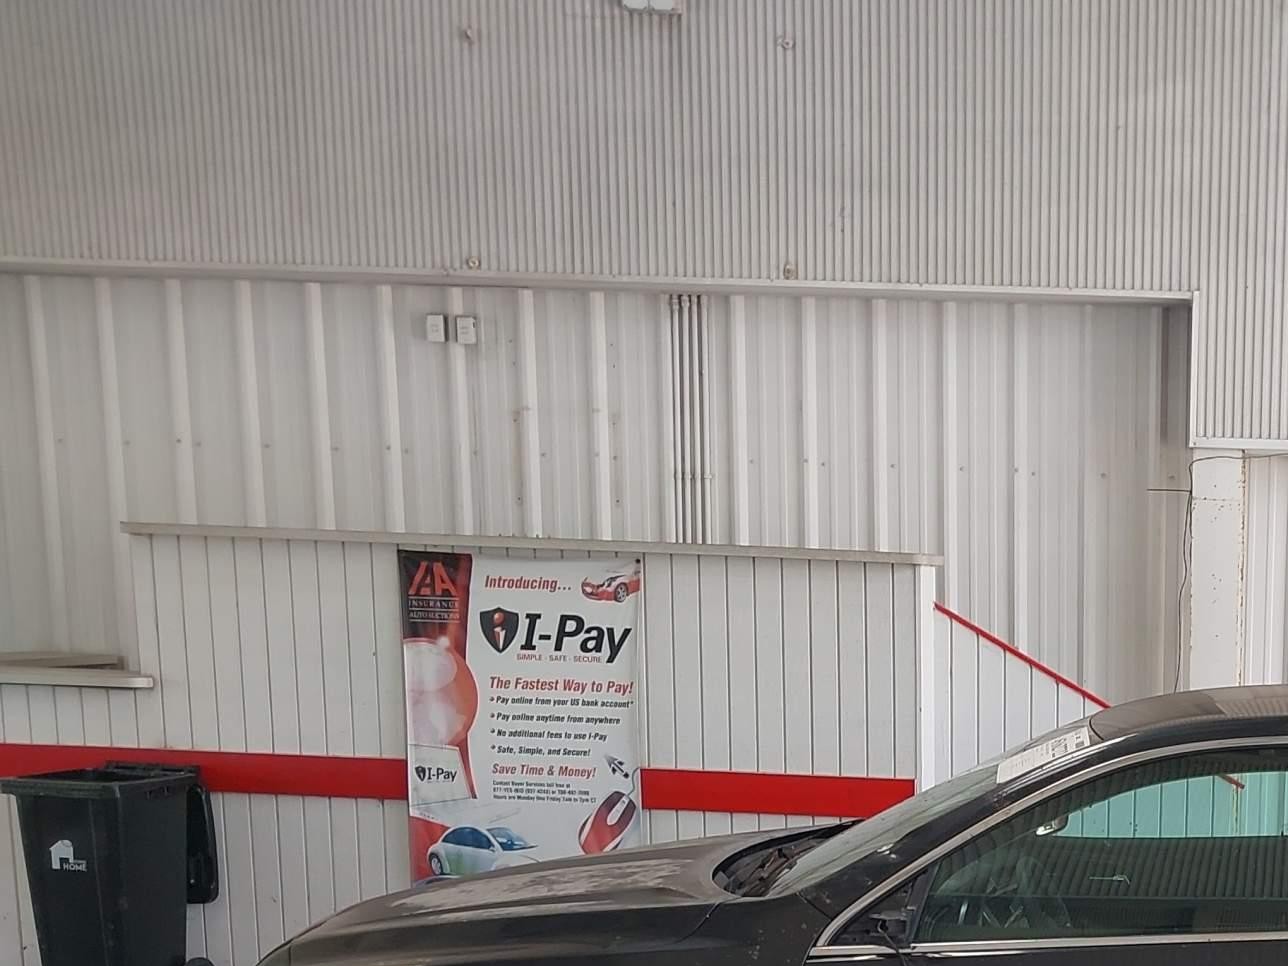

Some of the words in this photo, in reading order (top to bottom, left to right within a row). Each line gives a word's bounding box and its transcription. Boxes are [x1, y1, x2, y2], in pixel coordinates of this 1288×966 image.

[484, 575, 572, 593] Introducing...
[520, 613, 632, 664] I-Pay
[516, 653, 543, 662] SIMPLE
[549, 654, 568, 663] SAFE
[573, 655, 603, 664] SECURE
[490, 676, 511, 690] The
[514, 677, 560, 692] Fastest
[562, 678, 587, 695] Way
[591, 679, 603, 693] to
[606, 680, 634, 697] Pay!
[496, 695, 510, 706] Pay
[511, 696, 534, 705] online
[535, 697, 552, 706] from
[553, 698, 569, 708] your
[570, 698, 581, 707] US
[581, 698, 599, 708] bank
[496, 711, 511, 722] Pay
[511, 713, 535, 722] online
[536, 714, 566, 724] anytime
[567, 714, 584, 724] from
[585, 716, 621, 726] anywhere
[496, 728, 507, 737] No
[508, 729, 546, 739] additional
[547, 730, 563, 739] fees
[564, 731, 572, 739] to
[588, 731, 608, 743] I-Pay
[496, 745, 516, 756] Safe,
[518, 745, 545, 757] Simple,
[547, 747, 561, 756] and
[562, 747, 591, 757] Secure!
[427, 766, 458, 783] I-Pay
[492, 762, 517, 775] Save
[520, 763, 545, 777] Time
[547, 764, 555, 777] &
[558, 765, 597, 780] Money!
[62, 862, 88, 872] HOME
